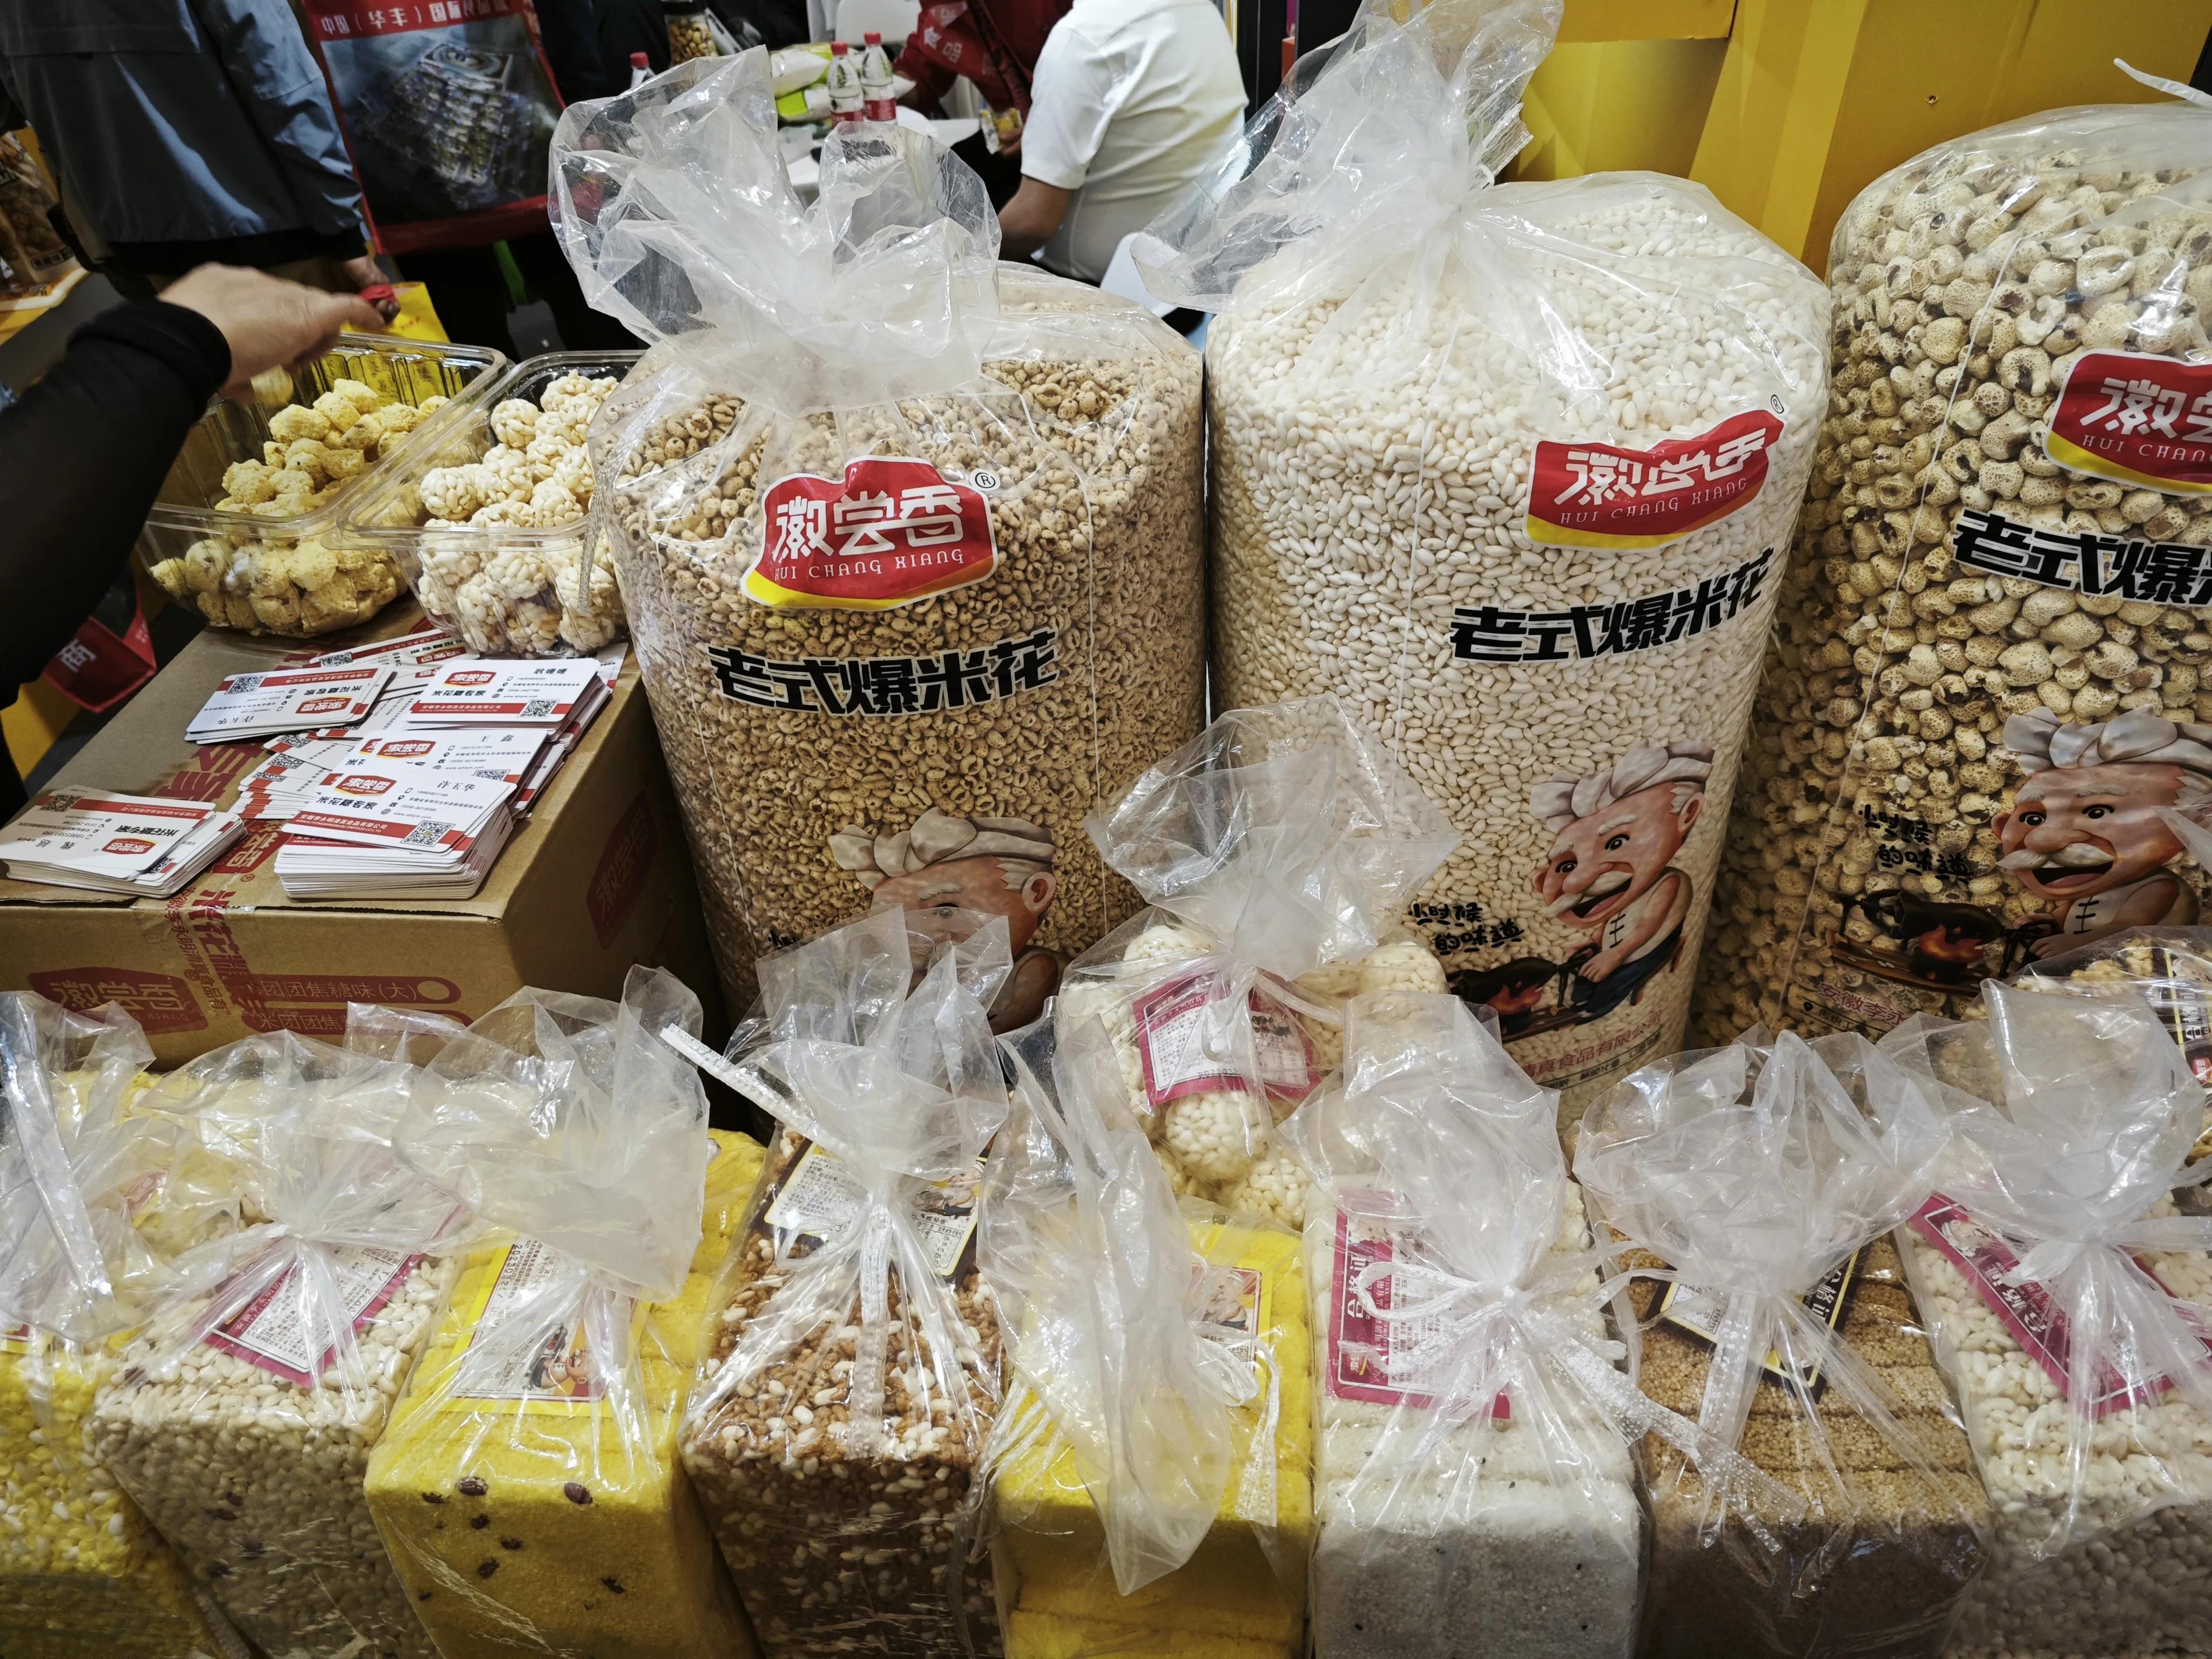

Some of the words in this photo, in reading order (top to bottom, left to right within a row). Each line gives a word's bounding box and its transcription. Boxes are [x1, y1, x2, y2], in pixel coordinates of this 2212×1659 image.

[2082, 434, 2122, 453] HUI
[1554, 428, 1766, 505] 徽尝香
[1560, 510, 1598, 524] HUI
[1610, 498, 1680, 518] CHANG
[1691, 478, 1748, 505] XIANG
[772, 484, 965, 563] 徽尝香
[774, 563, 797, 581] HUI
[809, 558, 882, 578] CHANG
[895, 548, 965, 570] XIANG
[1953, 509, 2212, 605] 老式爆
[1449, 547, 1775, 662] 老式爆米花
[304, 685, 363, 696] 米花糖专家
[709, 628, 1060, 716] 老式爆米花
[316, 795, 379, 810] 米花糖专家
[1859, 804, 1933, 846] 小时候
[1878, 844, 1973, 884] 的味道
[1408, 902, 1483, 927] 小时候
[1434, 918, 1525, 955] 的味道
